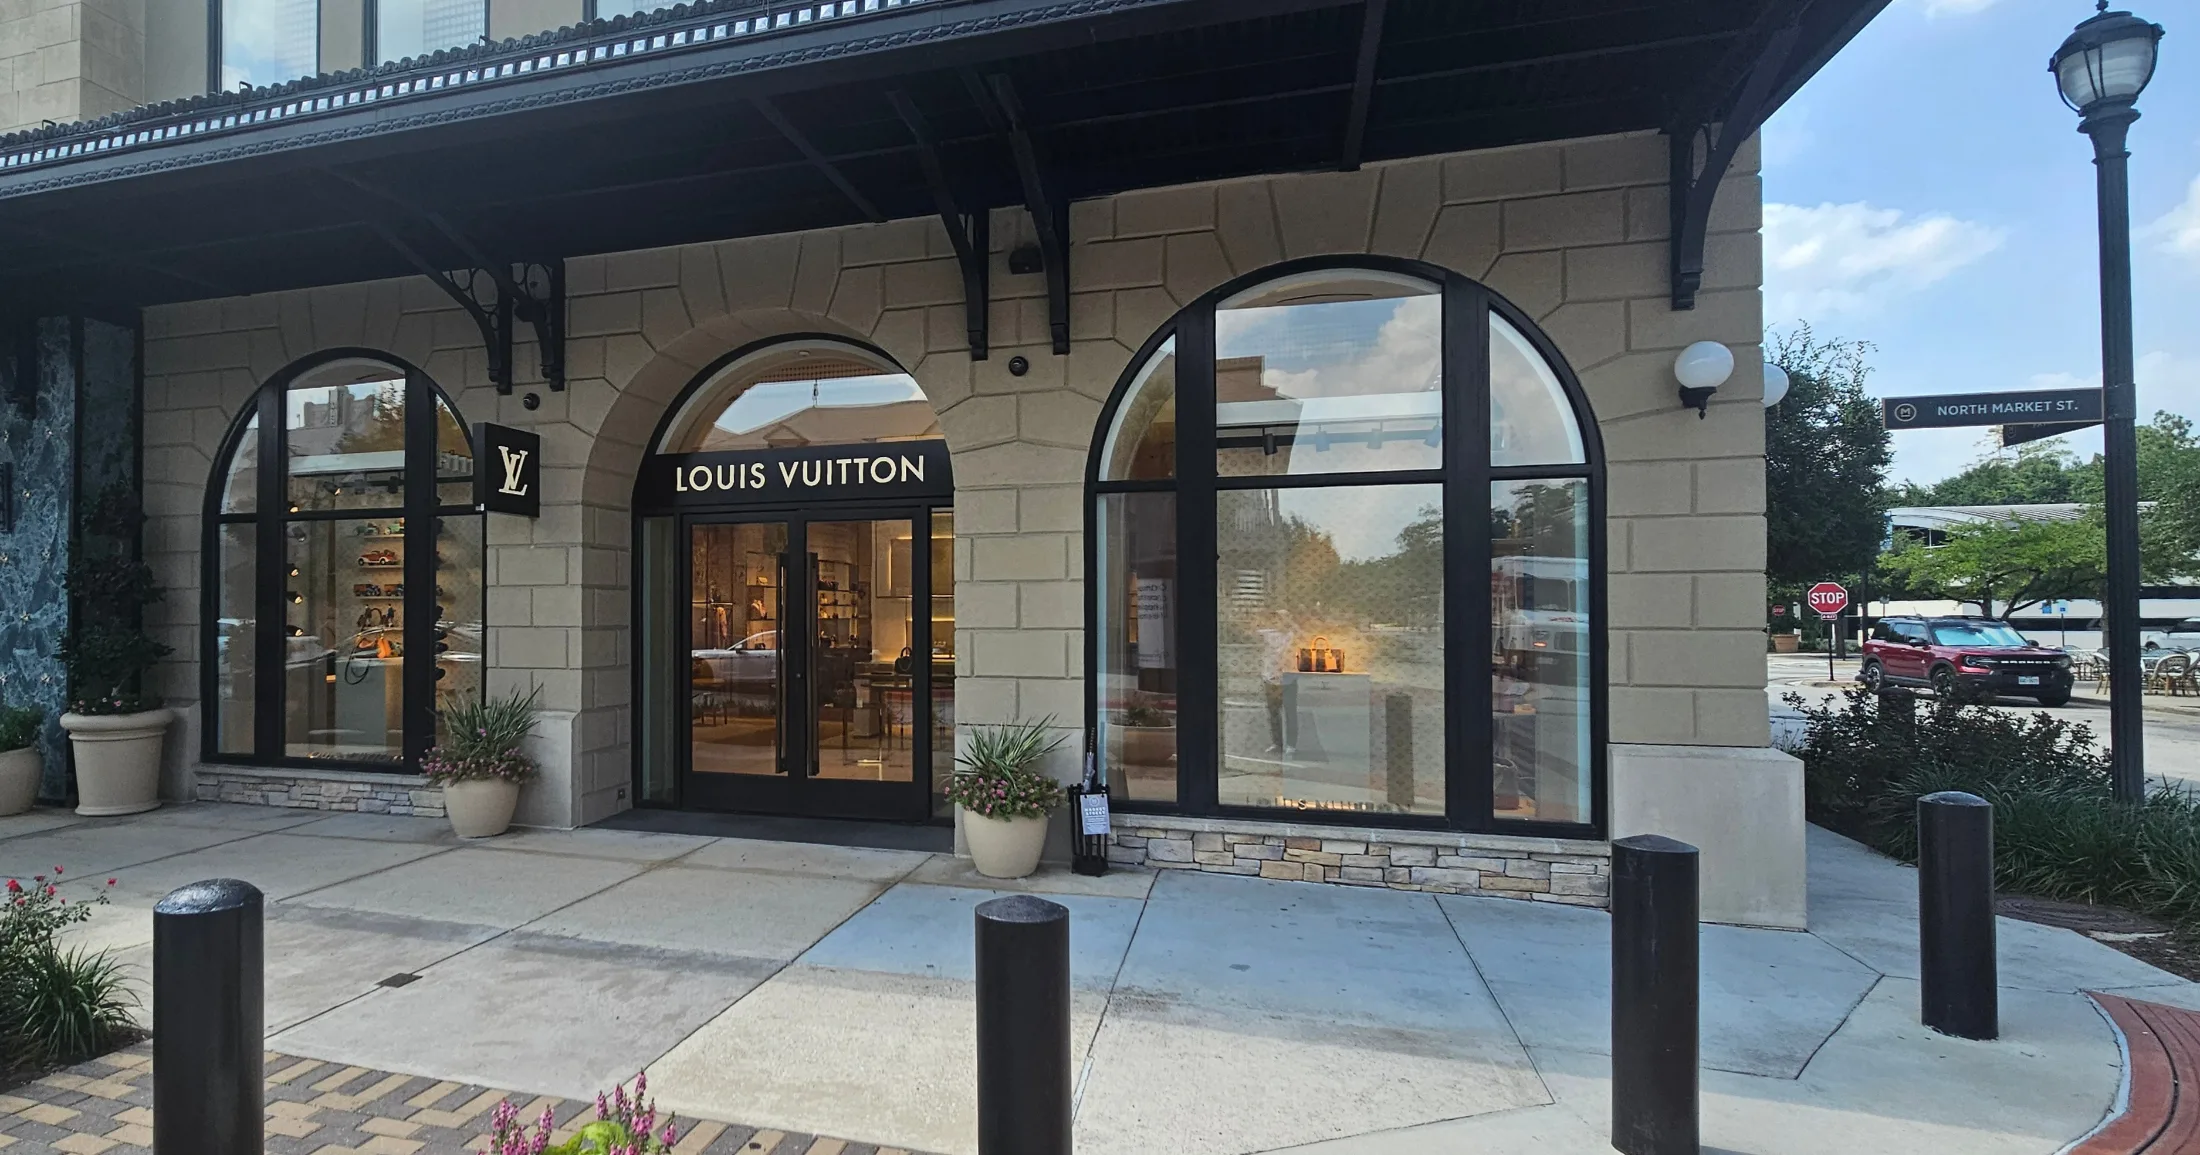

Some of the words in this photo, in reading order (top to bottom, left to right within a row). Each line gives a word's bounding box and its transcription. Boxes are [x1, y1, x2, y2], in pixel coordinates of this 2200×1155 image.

[1937, 403, 1987, 416] NORTH
[1992, 401, 2053, 413] MARKET
[2056, 400, 2079, 411] ST.
[676, 462, 766, 492] LOUIS
[778, 455, 925, 488] VUITTON
[1811, 592, 1845, 604] STOP
